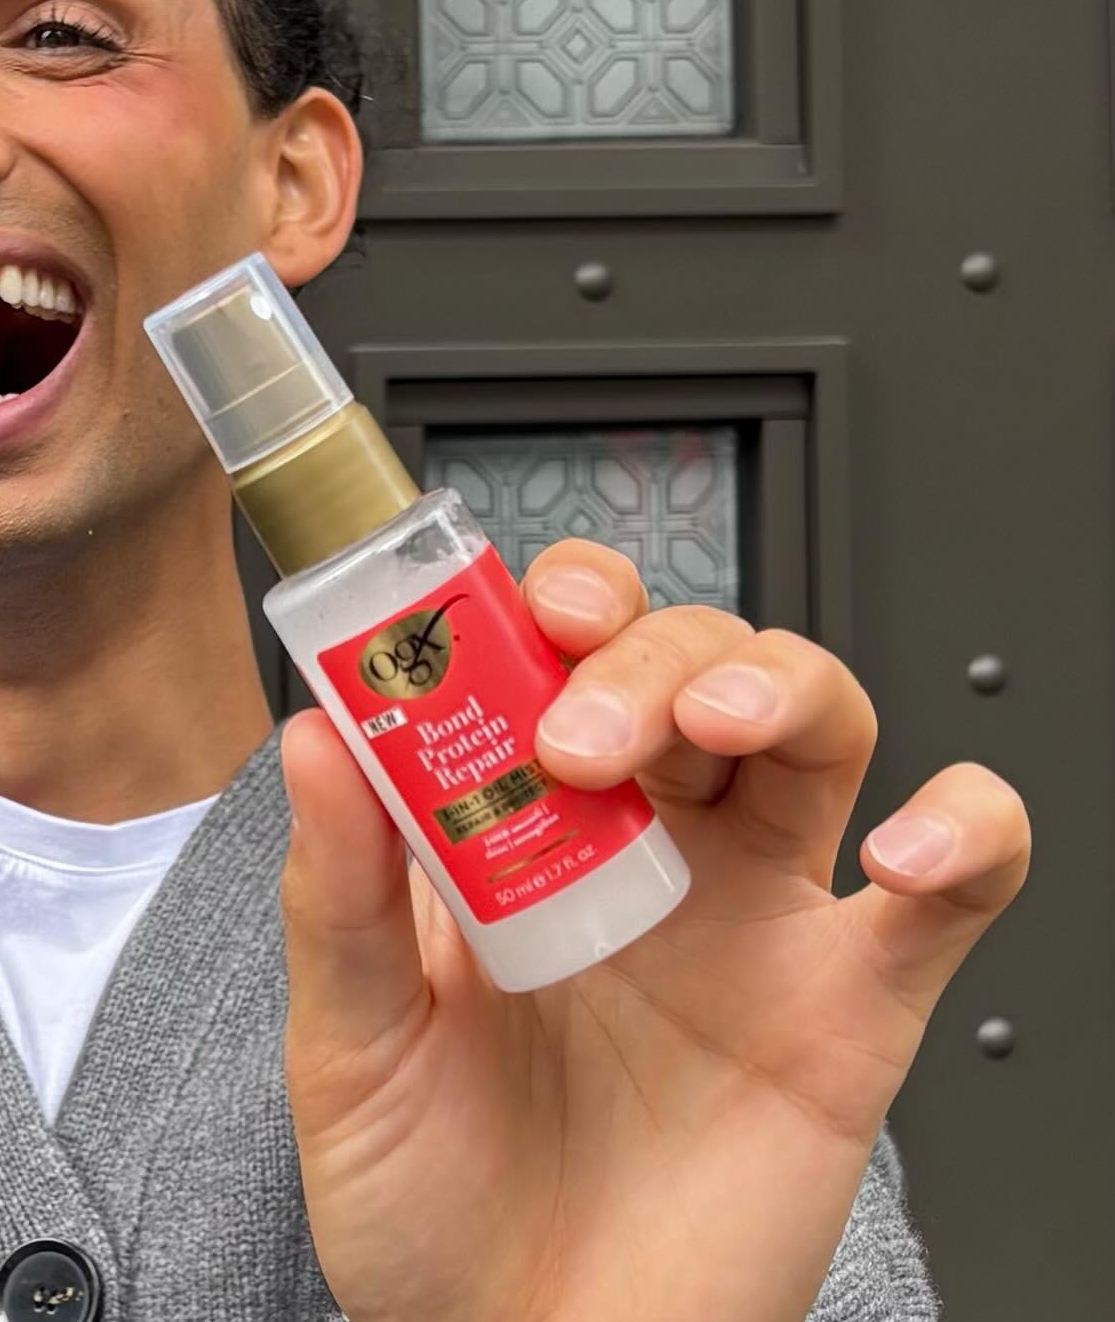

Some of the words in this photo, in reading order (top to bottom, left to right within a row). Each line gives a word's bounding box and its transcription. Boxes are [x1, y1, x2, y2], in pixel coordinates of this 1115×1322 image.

[367, 711, 398, 733] NEW
[416, 694, 484, 746] Bond
[417, 715, 510, 772] Protein
[434, 736, 516, 791] Repair
[482, 777, 511, 800] OIL
[495, 888, 516, 906] 50
